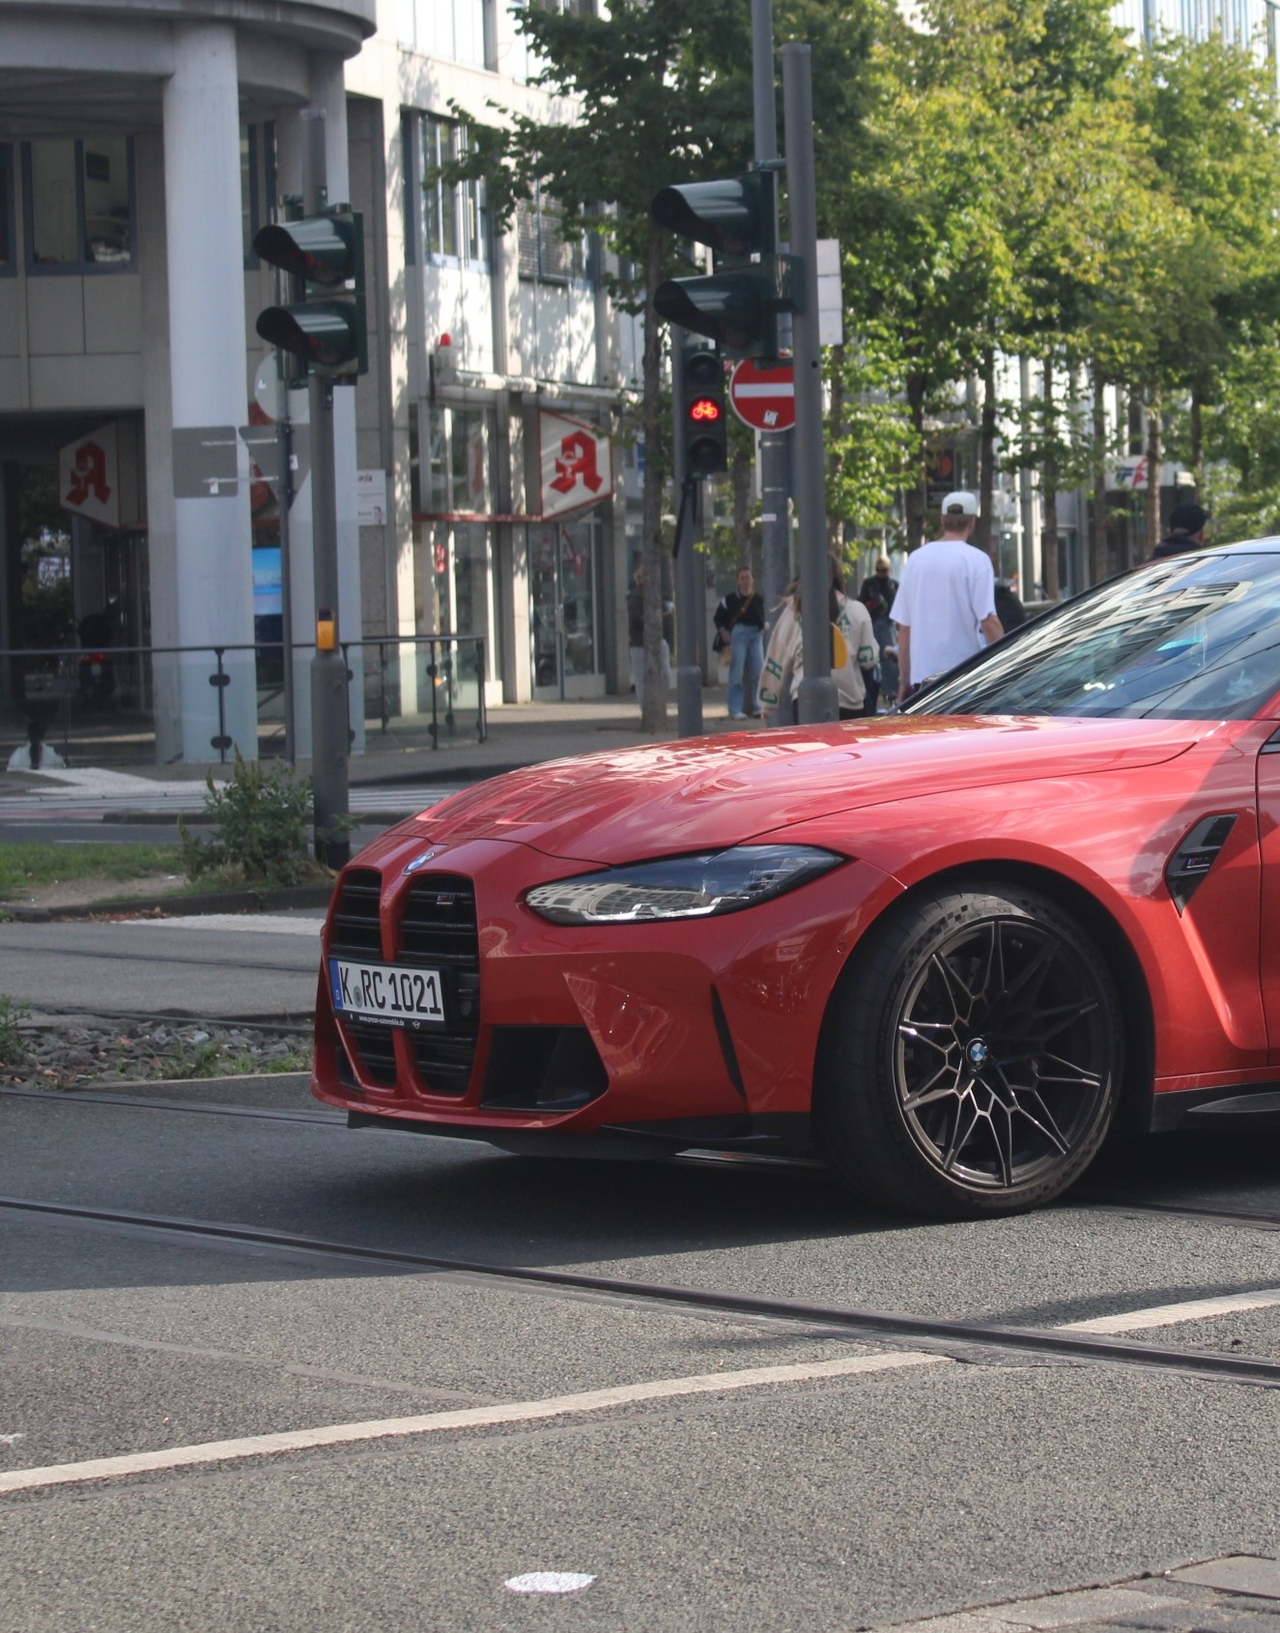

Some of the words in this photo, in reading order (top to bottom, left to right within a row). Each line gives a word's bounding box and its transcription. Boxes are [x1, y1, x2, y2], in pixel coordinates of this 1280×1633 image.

[340, 967, 353, 1005] K
[360, 969, 386, 1010] RC
[388, 972, 442, 1014] 1021
